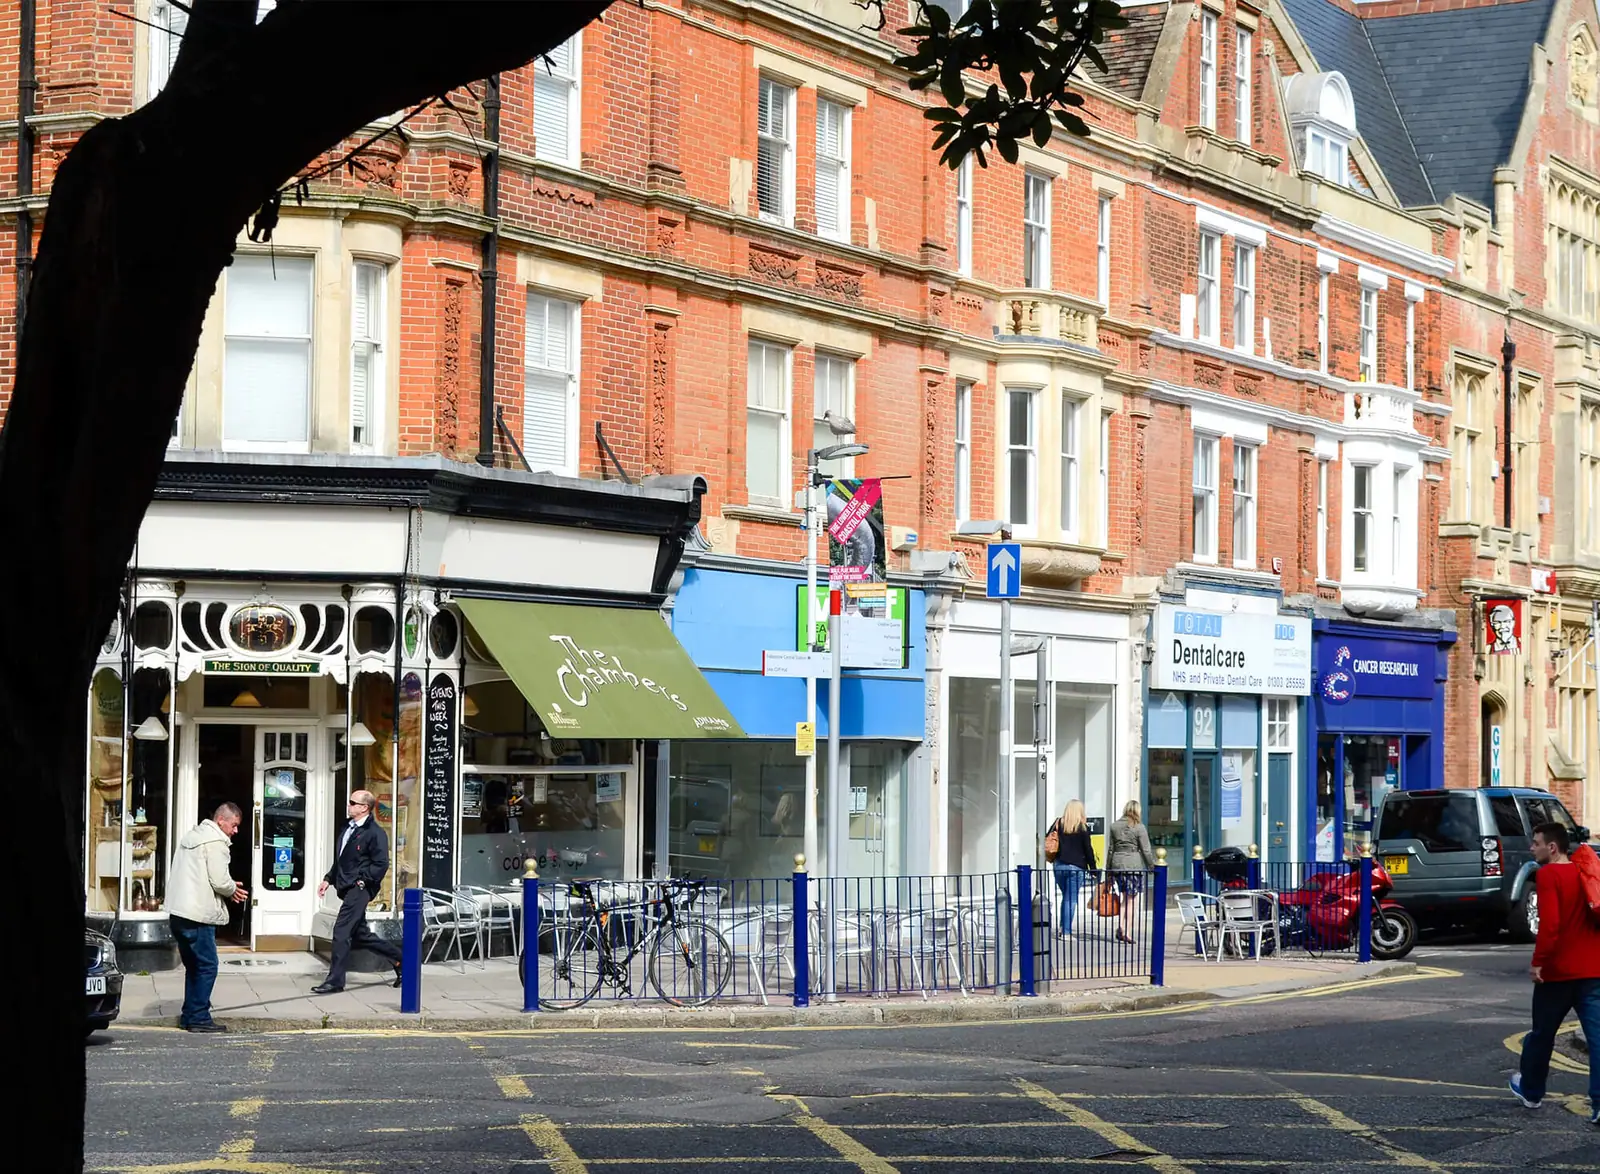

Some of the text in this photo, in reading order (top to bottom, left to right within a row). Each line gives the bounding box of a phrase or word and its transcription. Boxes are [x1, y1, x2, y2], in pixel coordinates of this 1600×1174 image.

[838, 501, 872, 542] COASTAL PARK
[549, 634, 609, 667] The
[1173, 639, 1245, 668] Dentalcare
[258, 663, 271, 672] OF
[272, 663, 312, 672] QUALITY
[1173, 670, 1186, 683] NHS
[1189, 672, 1201, 684] and
[1203, 672, 1225, 685] Private
[1227, 674, 1247, 686] Dental
[1249, 675, 1262, 687] Care
[1353, 659, 1418, 676] CANCER RESEARCH UK
[430, 686, 453, 699] EVENTS
[557, 656, 688, 711] Chambers
[429, 711, 448, 721] WEEK
[431, 700, 446, 711] THIS
[1194, 707, 1213, 736] 92
[1492, 727, 1500, 786] GYM
